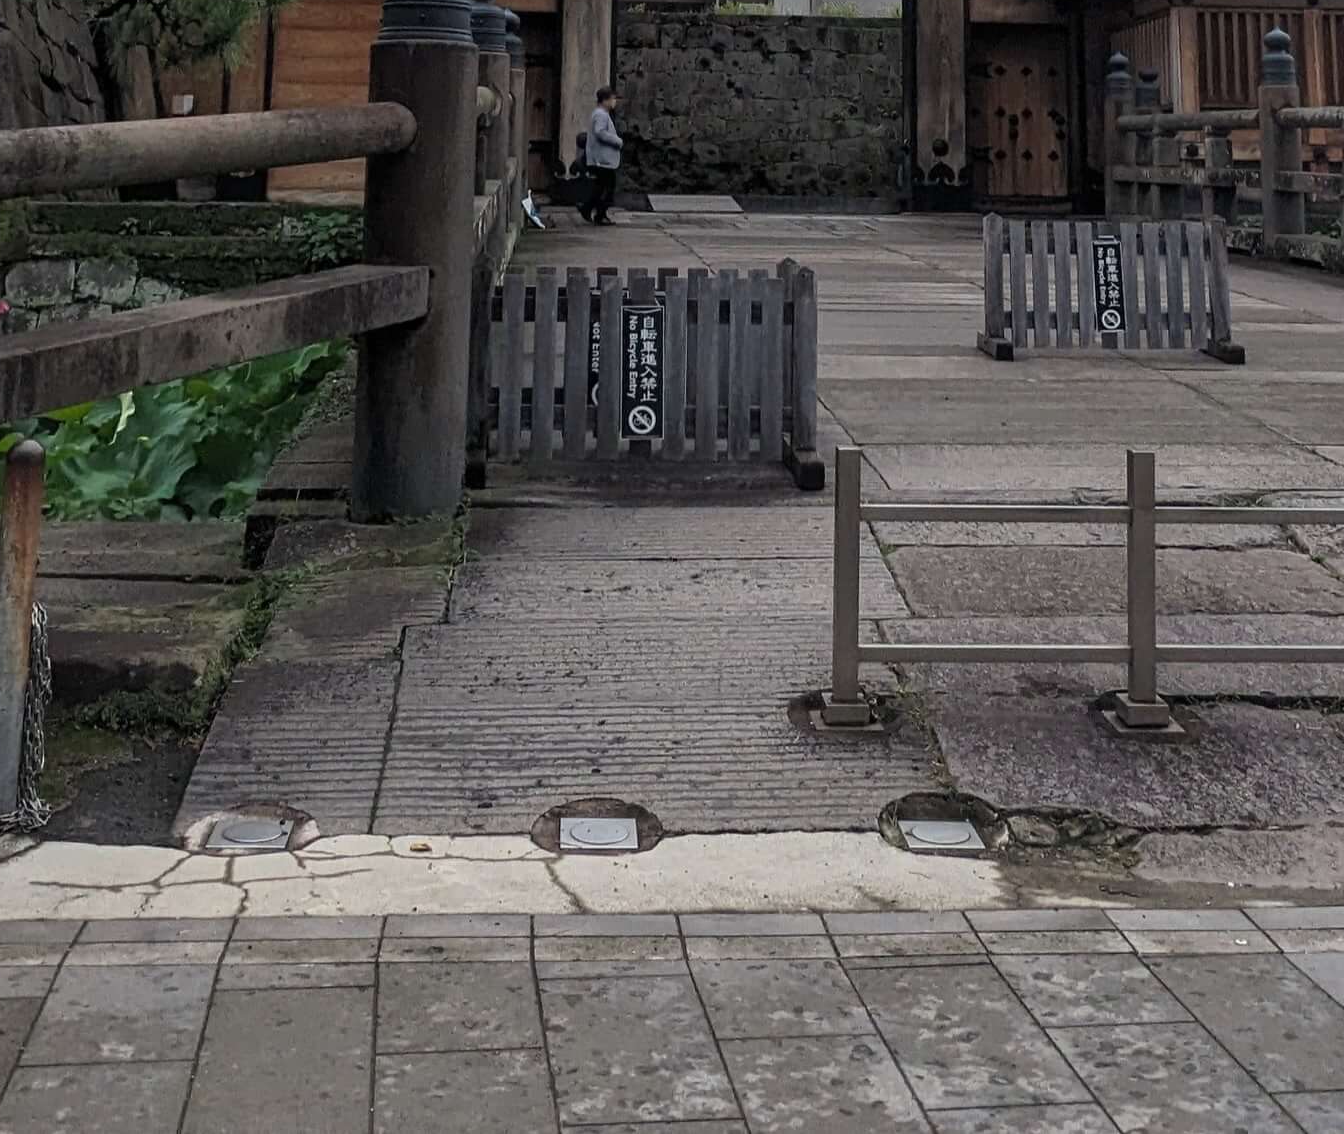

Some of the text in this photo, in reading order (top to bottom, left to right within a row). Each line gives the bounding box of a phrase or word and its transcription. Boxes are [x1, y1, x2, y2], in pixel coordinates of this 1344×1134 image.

[627, 316, 638, 399] No Bicycle Entry
[640, 316, 657, 402] 自転車進入禁止
